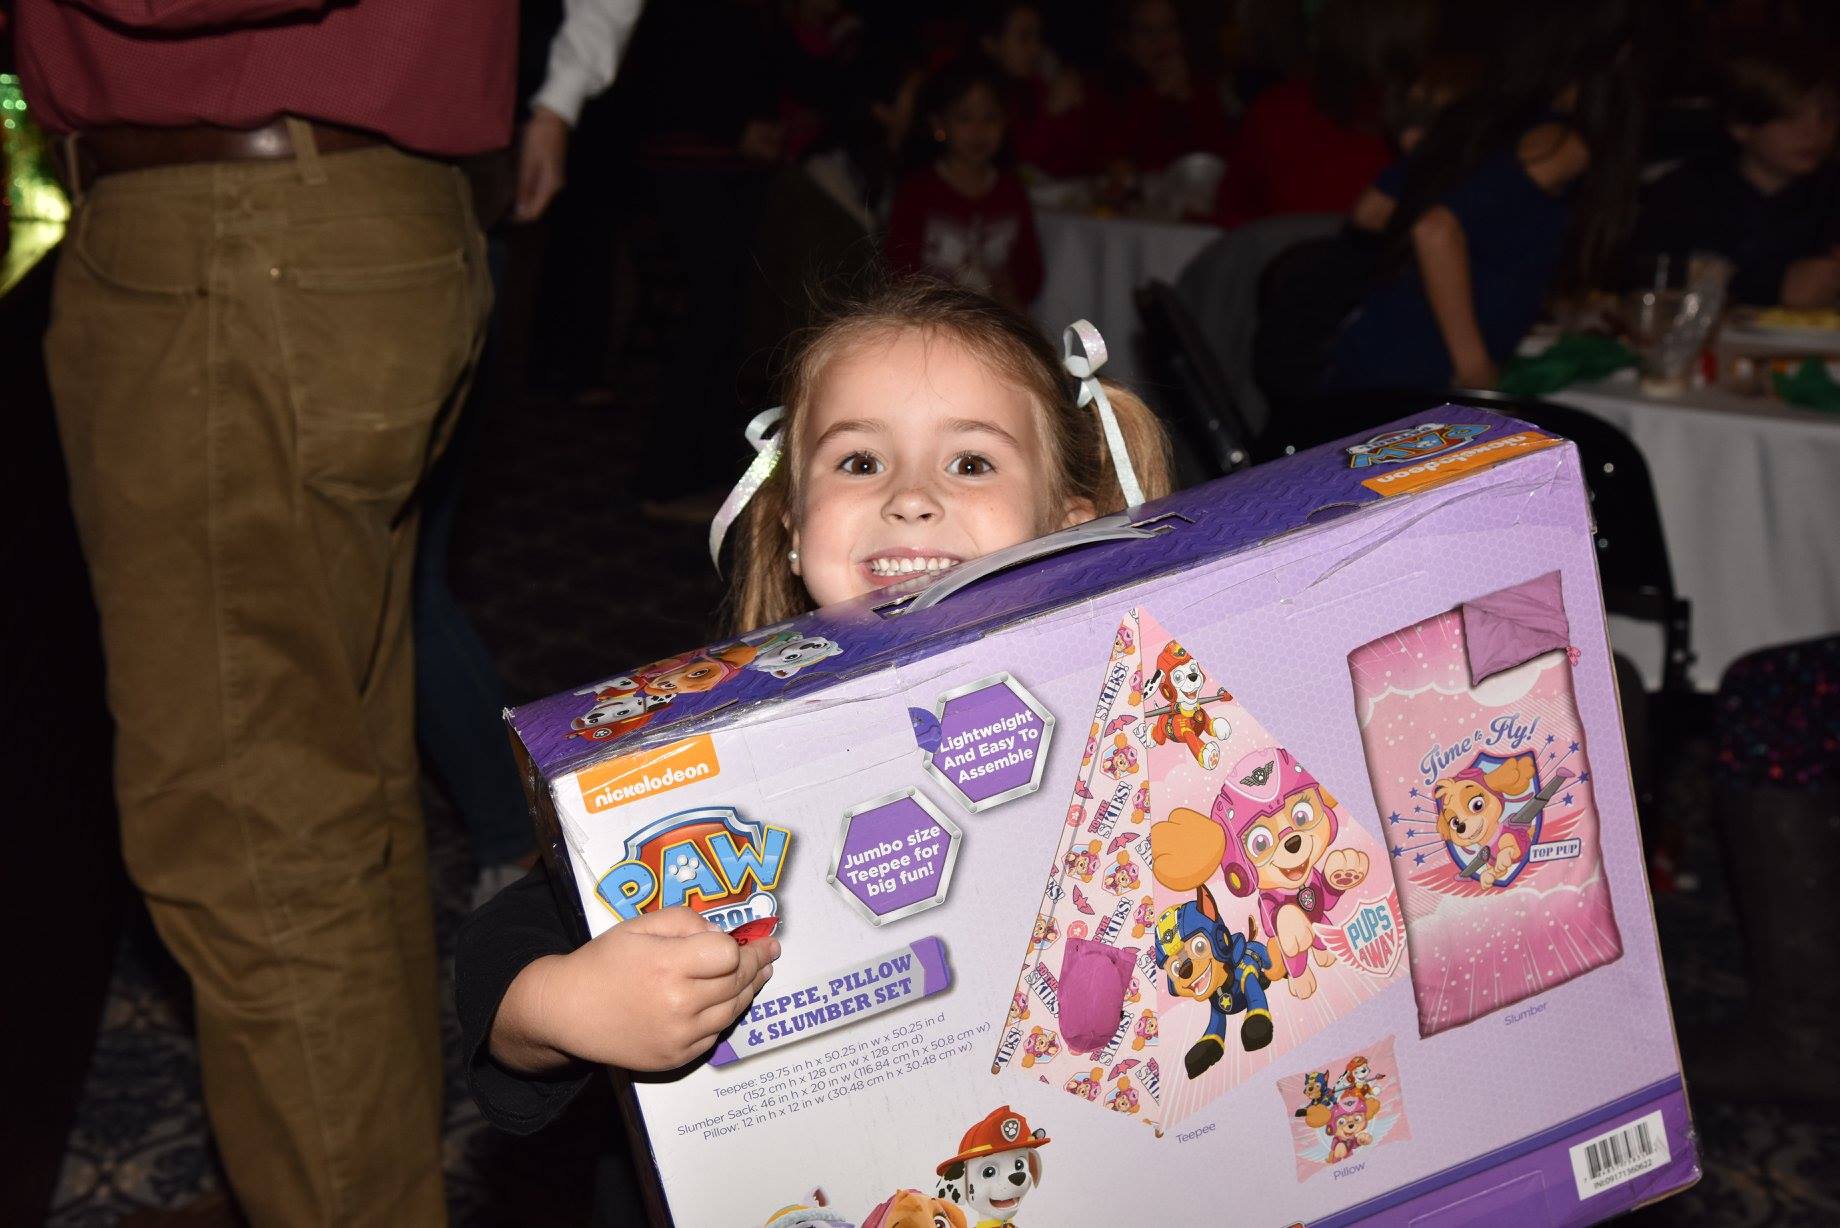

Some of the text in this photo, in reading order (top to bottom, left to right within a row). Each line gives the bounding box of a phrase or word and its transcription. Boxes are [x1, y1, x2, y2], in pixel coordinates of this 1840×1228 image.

[940, 709, 1034, 753] Lightweight
[944, 727, 1038, 771] And Easy To
[1420, 738, 1472, 785] Time
[1486, 713, 1540, 749] Fly!
[595, 762, 710, 808] nickelodeon
[958, 748, 1033, 783] Assemble
[1097, 781, 1133, 839] SKIES!
[844, 825, 941, 869] Jumbo size
[847, 842, 940, 885] Teepee for
[1532, 844, 1577, 859] TOP PUP
[594, 825, 791, 922] PAW
[867, 862, 935, 897] big fun!
[1347, 905, 1391, 949] PUPS
[1359, 929, 1394, 968] AWAY
[828, 953, 912, 998] PILLOW
[748, 977, 912, 1047] & SLUMBER SET
[1504, 1001, 1548, 1026] Slumber
[713, 1077, 758, 1098] Teepee:
[759, 1066, 790, 1084] 59.75
[792, 1063, 803, 1073] in
[805, 1060, 813, 1069] h
[824, 1045, 856, 1064] 50.25
[858, 1041, 869, 1051] in
[870, 1038, 881, 1047] w
[892, 1020, 923, 1039] 50.25
[925, 1017, 935, 1028] in
[937, 1012, 945, 1023] d
[743, 1034, 924, 1103] (152 cm h x 128 cm w x 128 cm d)
[677, 1022, 991, 1136] Slumber Sack: 46 in h x 20 in w (116.84 cm h x 50.8 cm w)
[703, 1041, 973, 1140] Pillow: 12 in h x 12 in w (30.48 cm h x 30.48 cm w)
[1176, 1122, 1217, 1144] Teepee
[1333, 1161, 1366, 1180] Pillow
